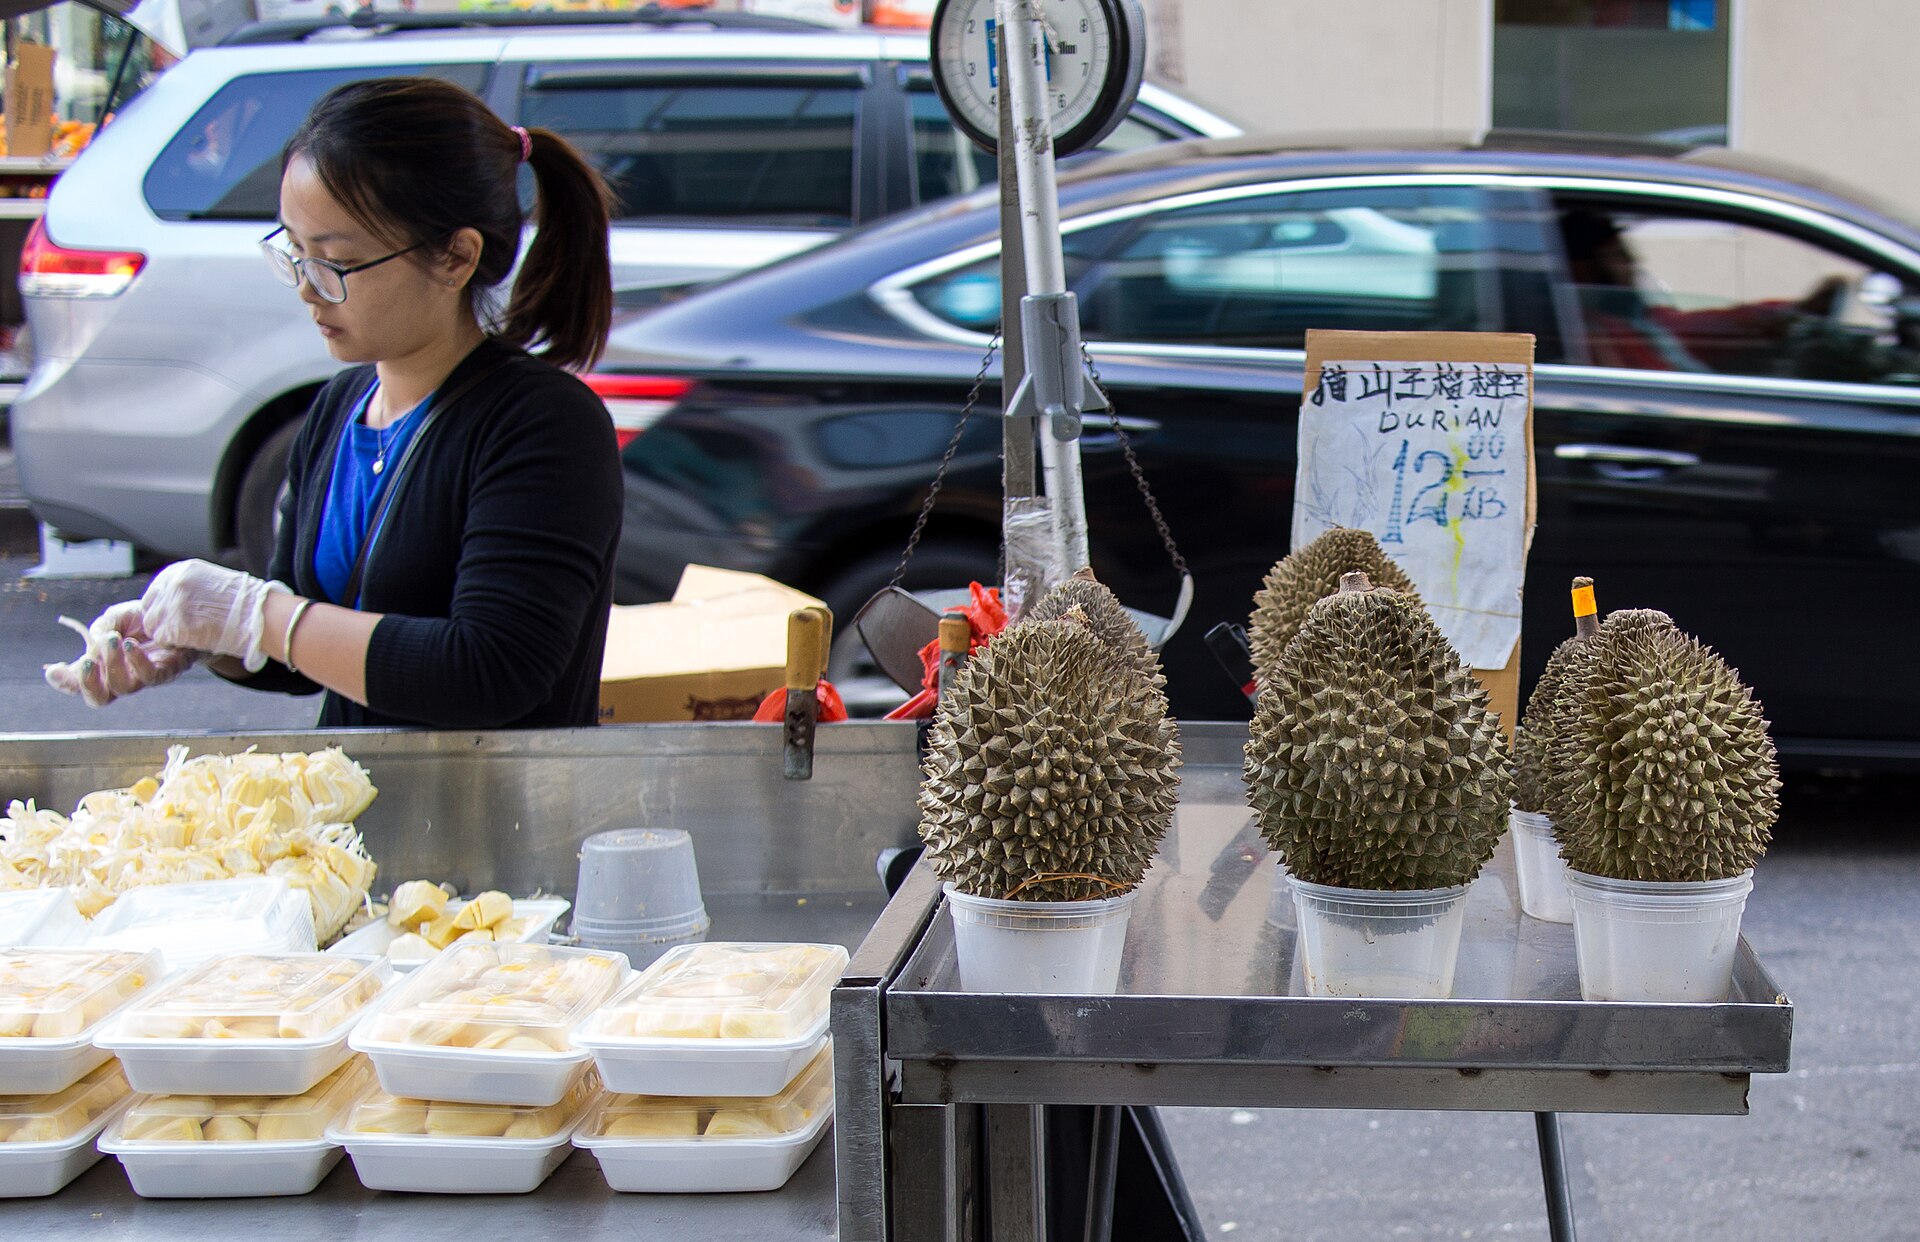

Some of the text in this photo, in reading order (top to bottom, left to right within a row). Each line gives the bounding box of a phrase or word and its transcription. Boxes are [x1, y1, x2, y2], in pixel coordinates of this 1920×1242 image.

[968, 18, 976, 34] 2
[967, 62, 976, 77] 3
[1381, 439, 1452, 543] 12
